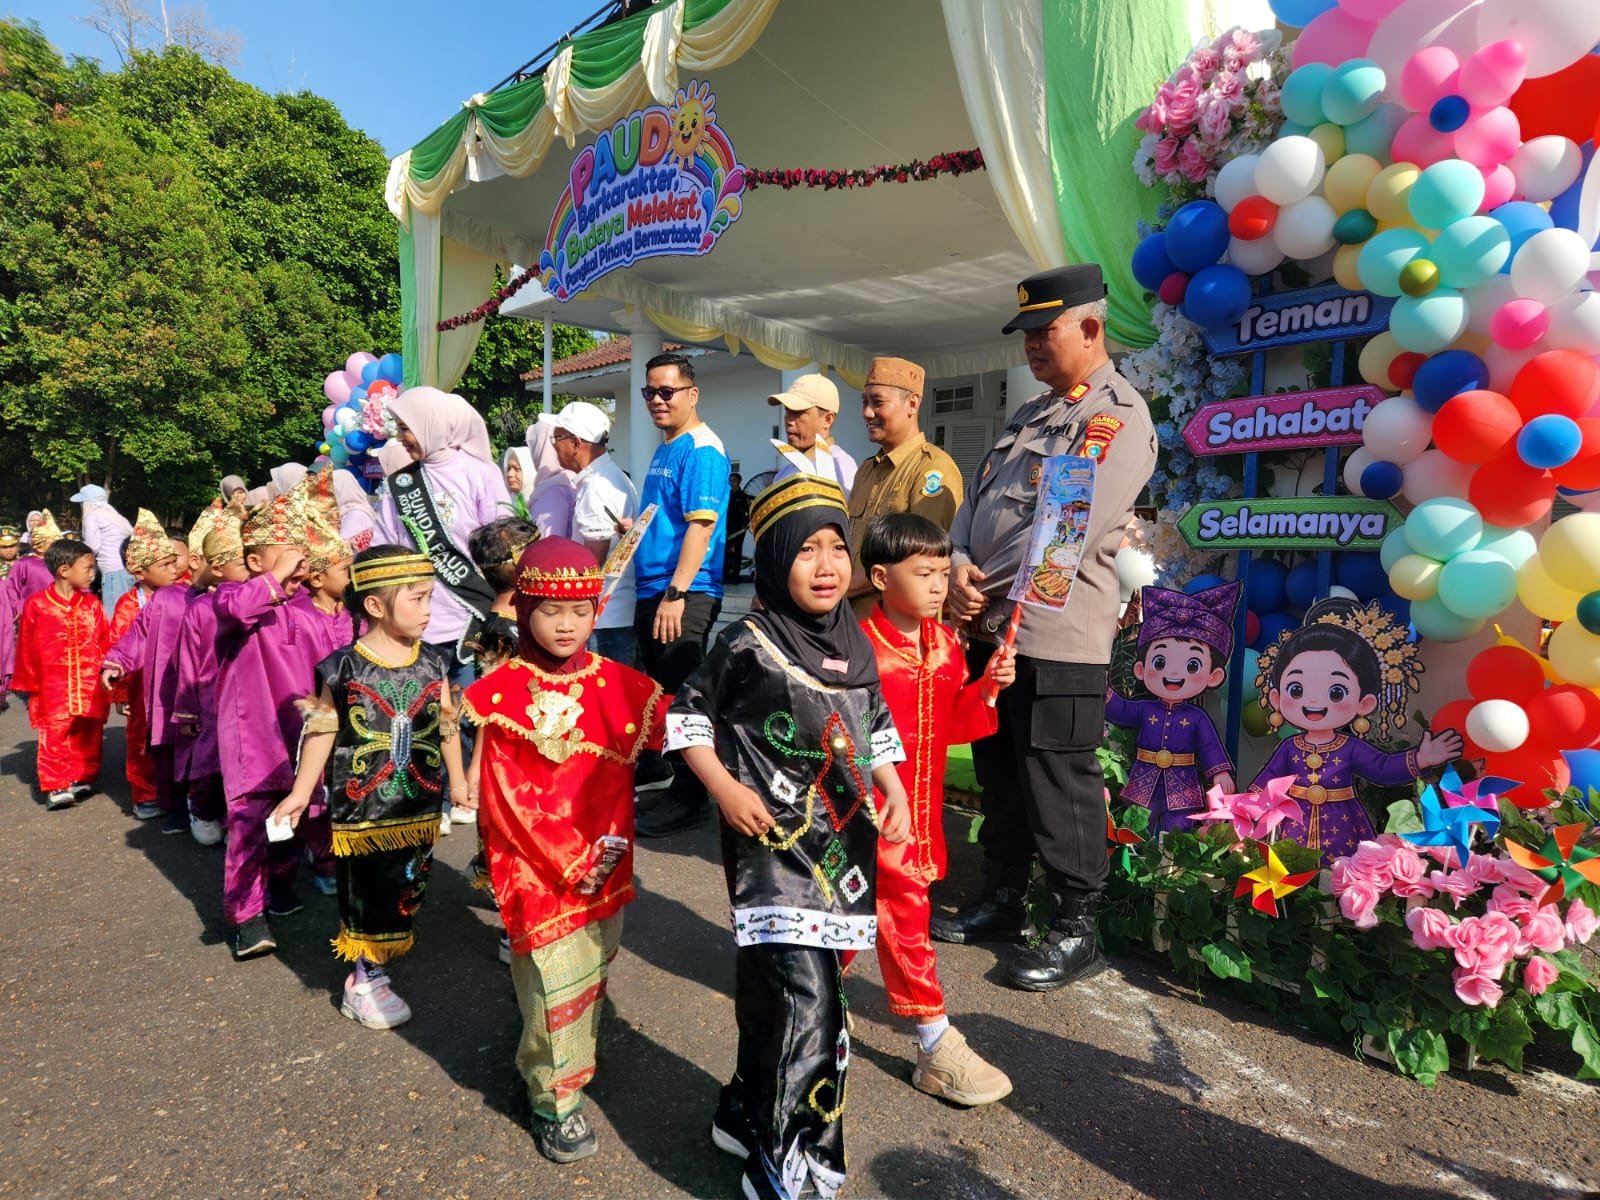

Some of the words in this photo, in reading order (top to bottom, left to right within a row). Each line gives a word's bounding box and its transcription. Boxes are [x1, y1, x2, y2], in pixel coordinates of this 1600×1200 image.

[571, 111, 671, 209] PAUD
[566, 211, 625, 267] Budaya
[627, 190, 701, 231] Melekat,
[578, 167, 679, 233] Berkarakter,
[565, 256, 599, 290] Pangkal
[599, 237, 632, 264] Pinang
[634, 223, 702, 250] Bermartabat
[1237, 295, 1370, 344] Teman
[1207, 399, 1372, 446] Sahabat
[398, 494, 412, 517] KOTA
[408, 488, 437, 542] BUNDA
[430, 543, 469, 579] PAUD
[1199, 507, 1386, 543] Selamanya
